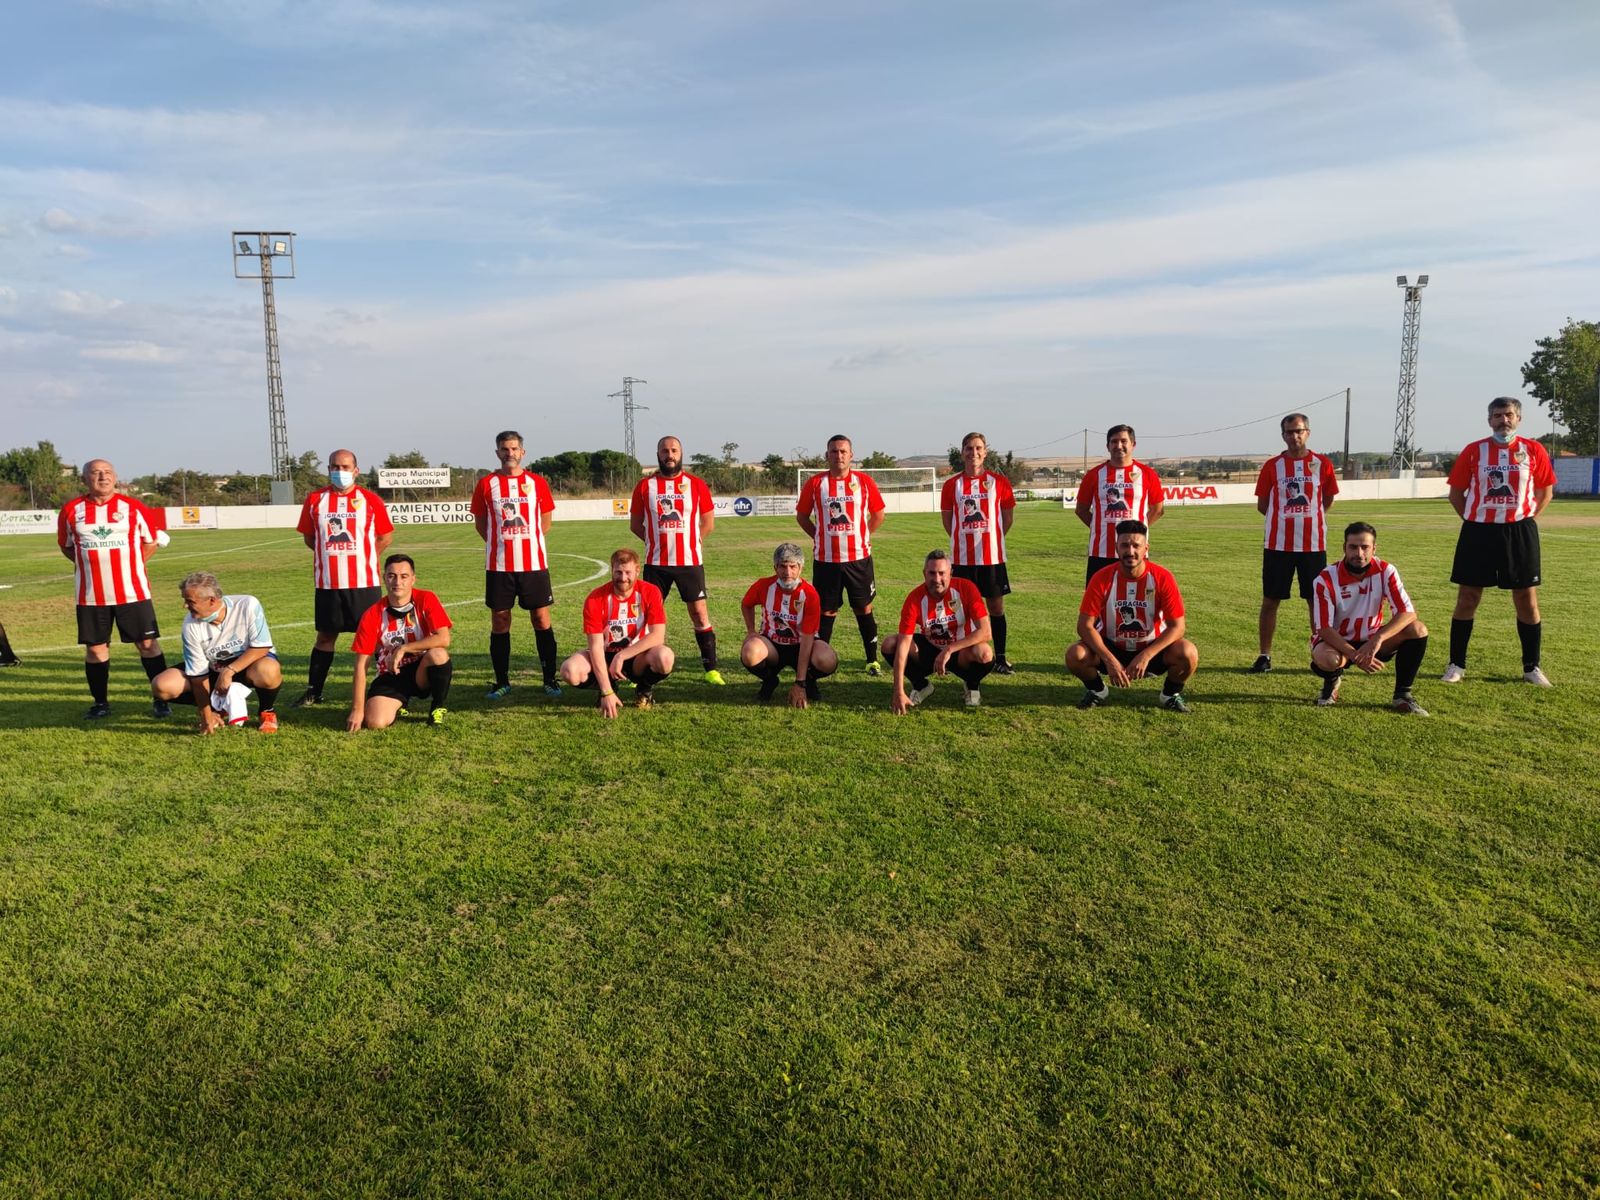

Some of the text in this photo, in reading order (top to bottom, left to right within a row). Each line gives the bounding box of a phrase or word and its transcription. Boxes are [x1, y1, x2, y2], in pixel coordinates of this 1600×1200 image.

[410, 470, 448, 478] Municipal
[413, 515, 437, 523] DEL
[442, 514, 474, 522] VINO
[326, 542, 356, 550] PIBE!
